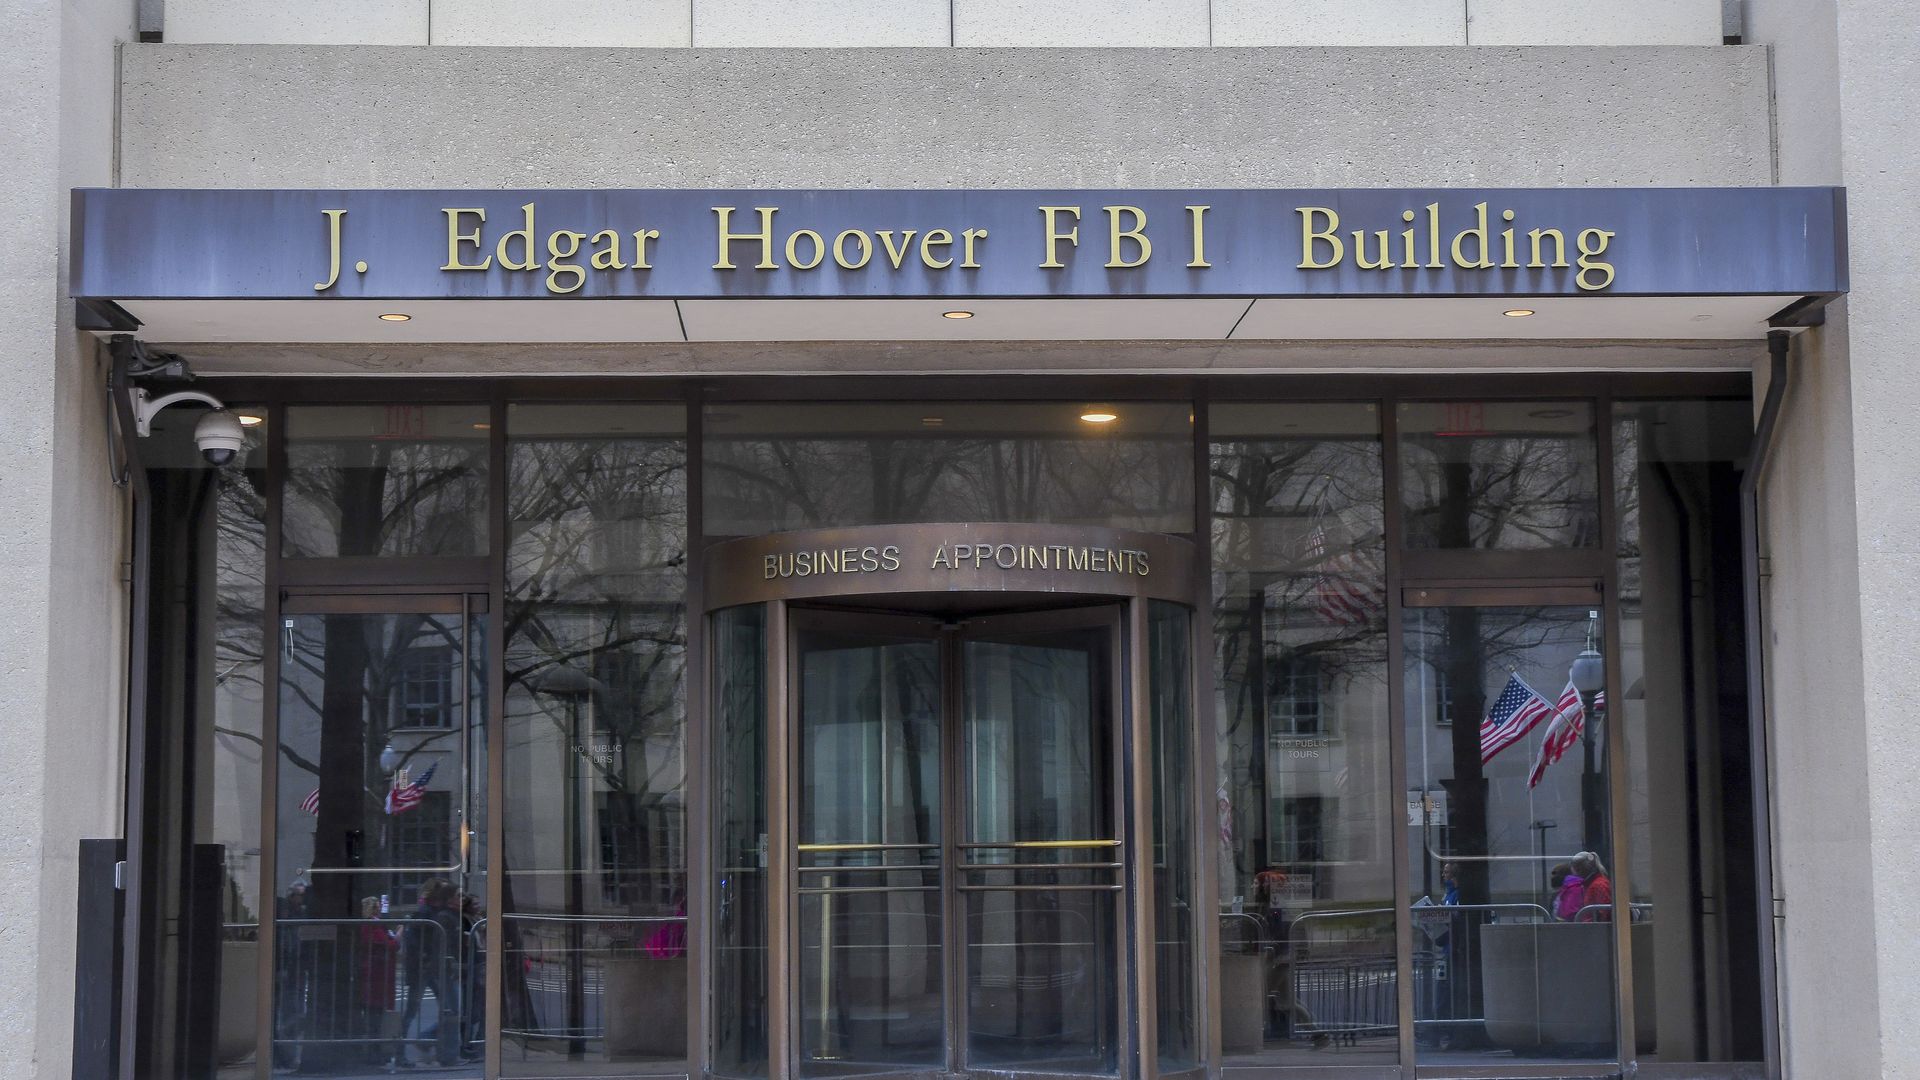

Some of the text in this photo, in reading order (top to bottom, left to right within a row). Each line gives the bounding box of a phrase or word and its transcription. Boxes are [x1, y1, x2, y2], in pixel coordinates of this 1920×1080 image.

[313, 207, 369, 291] J.
[441, 202, 661, 294] Edgar
[711, 205, 988, 271] Hoover
[1295, 201, 1616, 290] Building
[763, 543, 1150, 580] BUSINESS APPOINTMENTS
[1277, 739, 1329, 748] NO PUBLIC
[570, 744, 623, 753] NO PUBLIC
[1288, 750, 1320, 759] TOURS
[581, 755, 613, 764] TOURS
[1409, 800, 1441, 809] BAE
